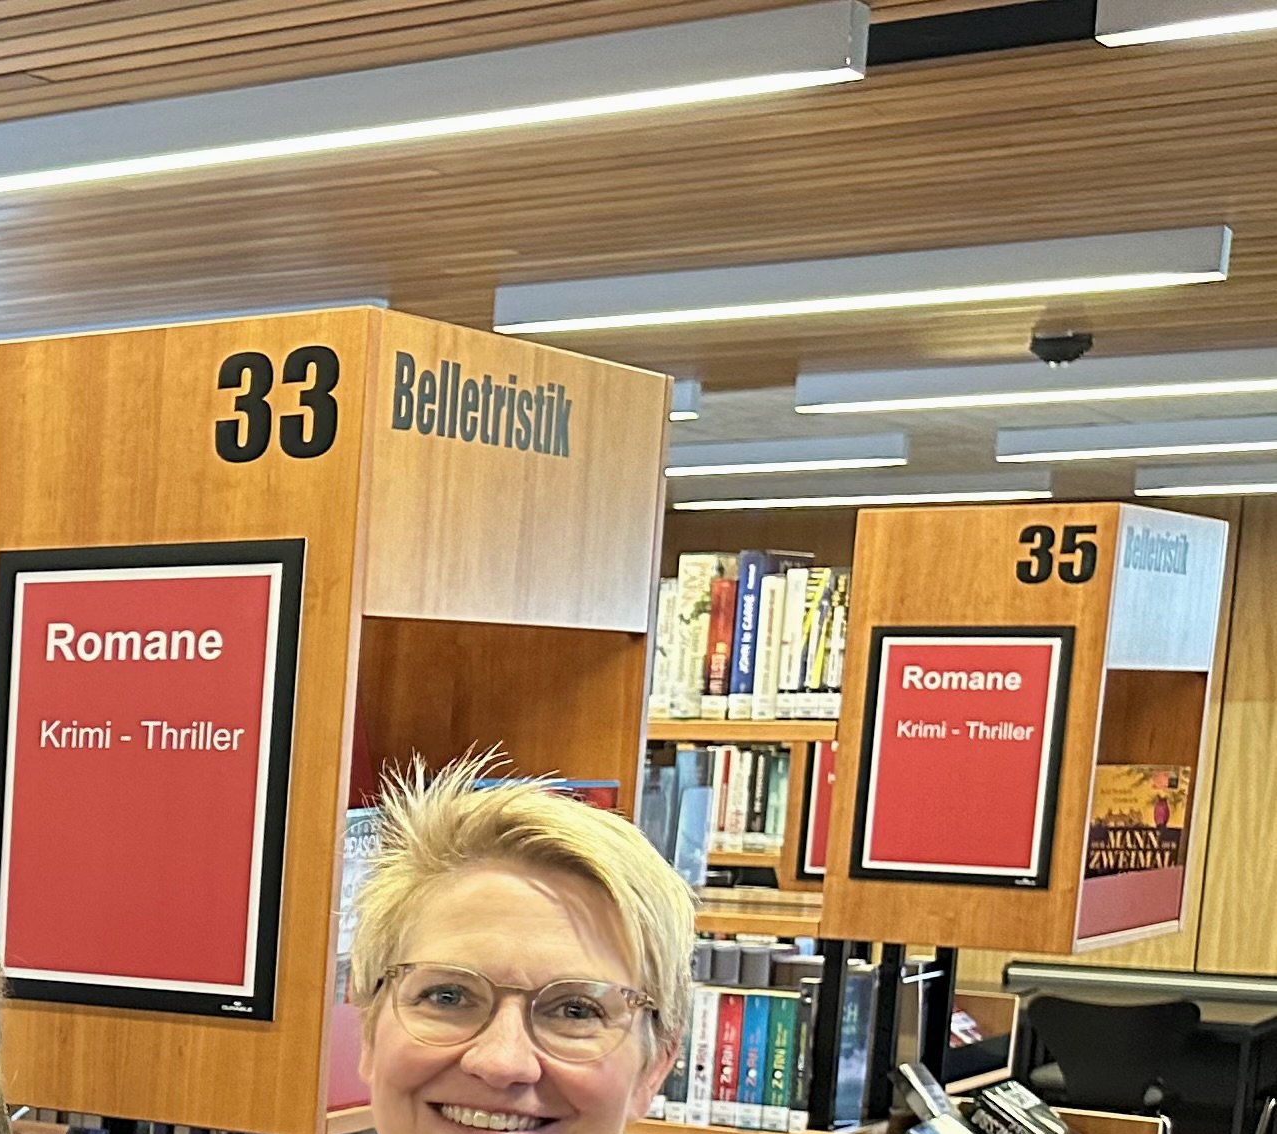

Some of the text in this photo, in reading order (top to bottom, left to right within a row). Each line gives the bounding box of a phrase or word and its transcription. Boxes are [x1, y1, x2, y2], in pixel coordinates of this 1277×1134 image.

[215, 345, 340, 464] 33
[391, 350, 573, 459] Belletristik
[1015, 525, 1098, 584] 35
[1123, 527, 1189, 576] Belletristik
[45, 621, 223, 662] Romane
[902, 665, 1022, 692] Romane
[39, 720, 112, 750] Krimi
[141, 720, 245, 751] Thriller
[896, 720, 946, 740] Krimi
[965, 721, 1034, 742] Thriller
[1107, 830, 1161, 850] MANN
[1088, 849, 1175, 870] ZWEIMAL
